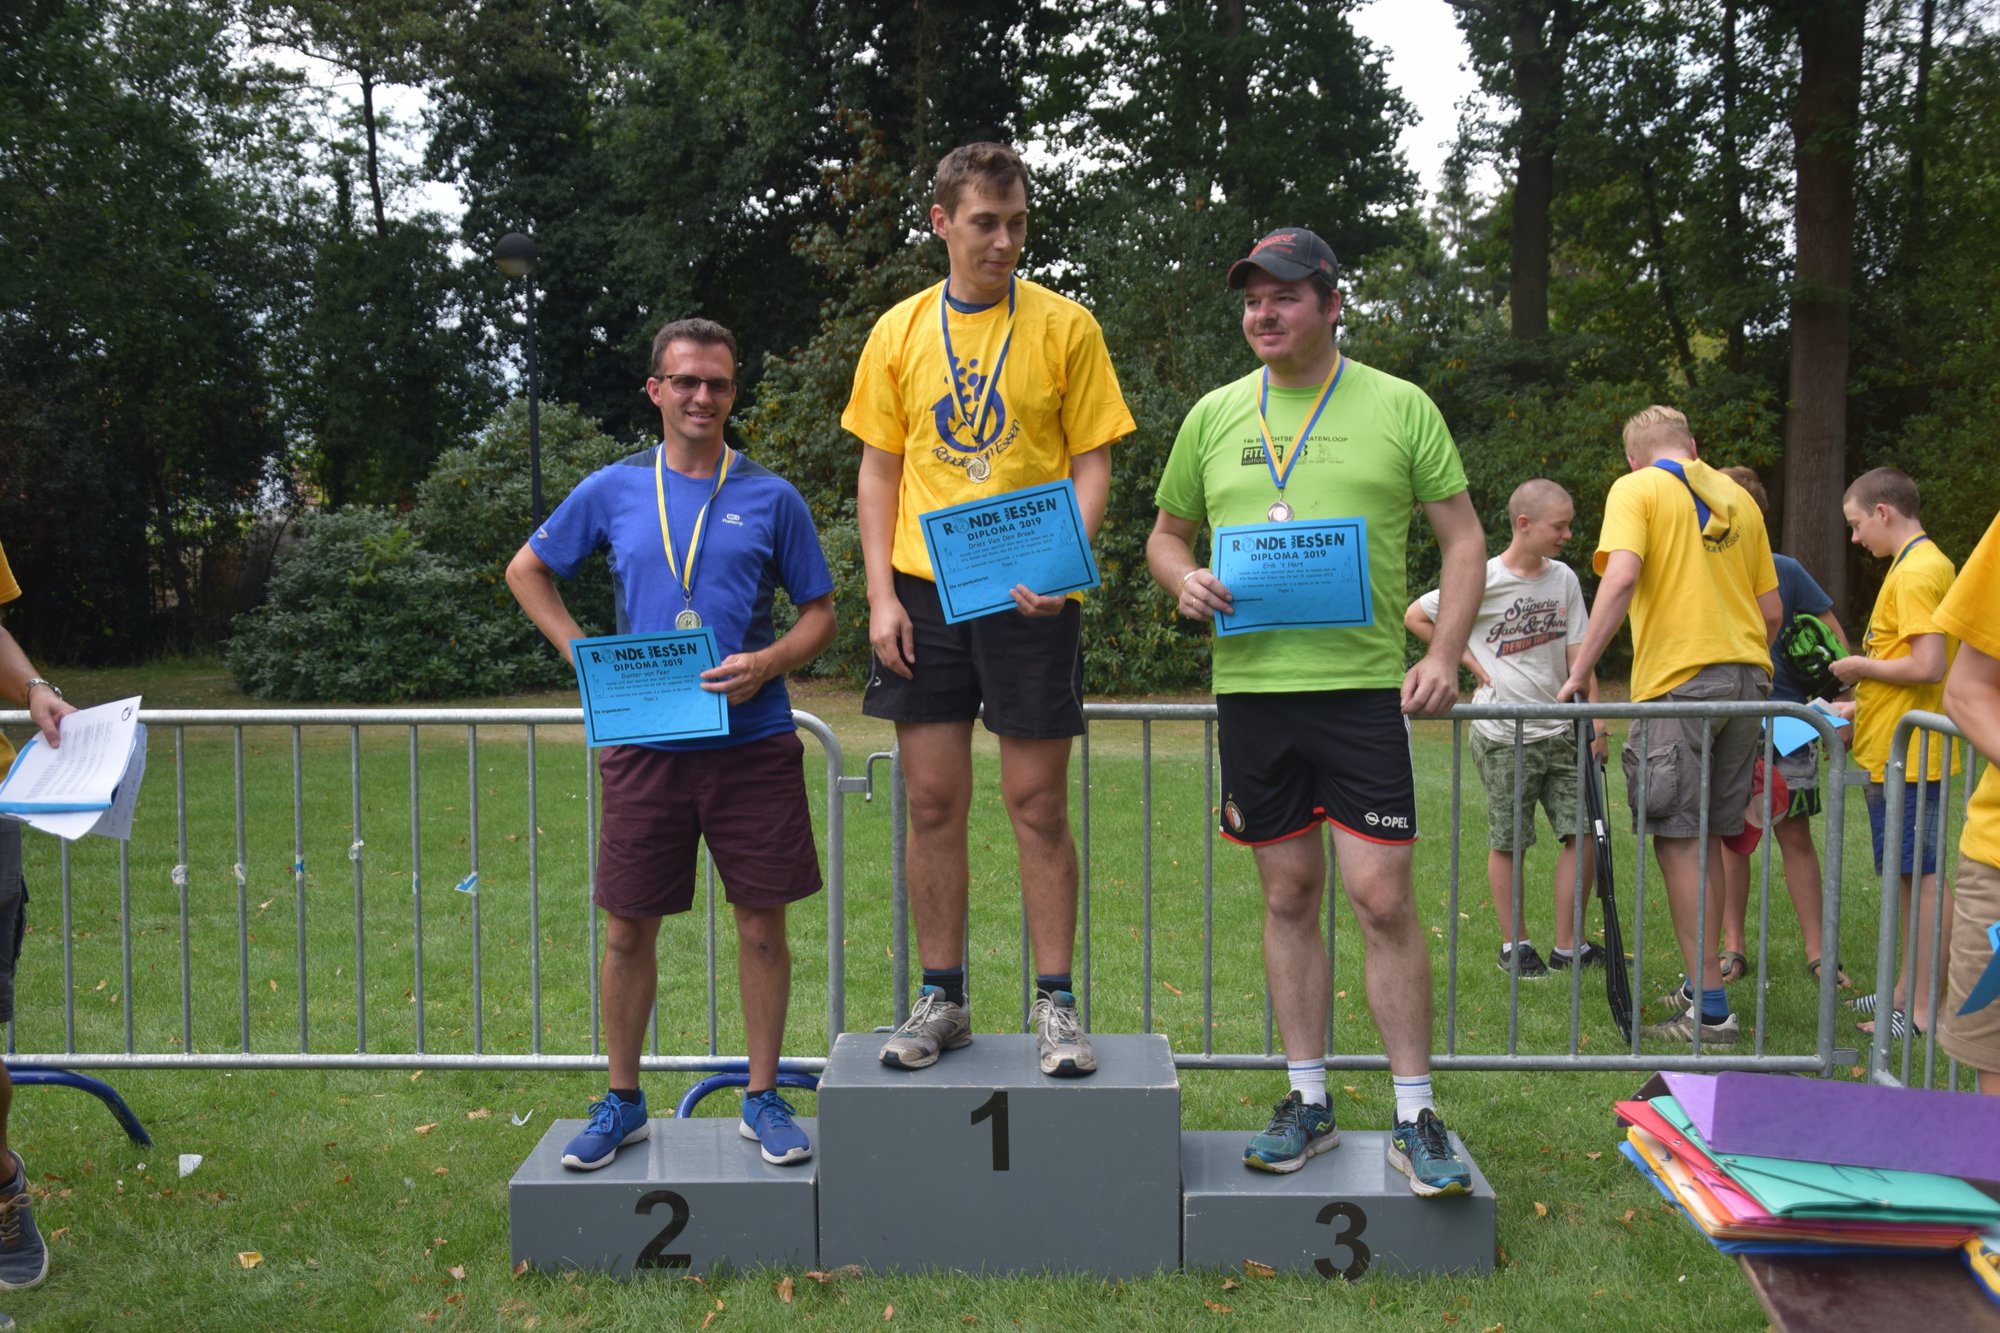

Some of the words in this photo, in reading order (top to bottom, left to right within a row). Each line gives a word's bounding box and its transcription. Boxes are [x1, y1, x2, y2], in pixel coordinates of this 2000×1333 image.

[995, 418, 1020, 454] Essen
[1243, 446, 1282, 459] FITLB
[1009, 497, 1057, 520] ESSEN
[967, 523, 1016, 542] DIPLOMA
[1019, 516, 1042, 529] 2019
[1296, 533, 1345, 549] ESSEN
[1250, 551, 1299, 562] DIPLOMA
[1303, 549, 1327, 559] 2019
[1505, 598, 1559, 622] Superior
[1486, 621, 1523, 643] Jack
[653, 642, 698, 658] ESSEN
[1502, 637, 1532, 654] DENIM
[613, 660, 659, 672] DIPLOMA
[662, 657, 683, 667] 2019
[1381, 815, 1409, 829] OPEL
[970, 1090, 1010, 1172] 1
[633, 1189, 692, 1270] 2
[1313, 1202, 1372, 1282] 3
